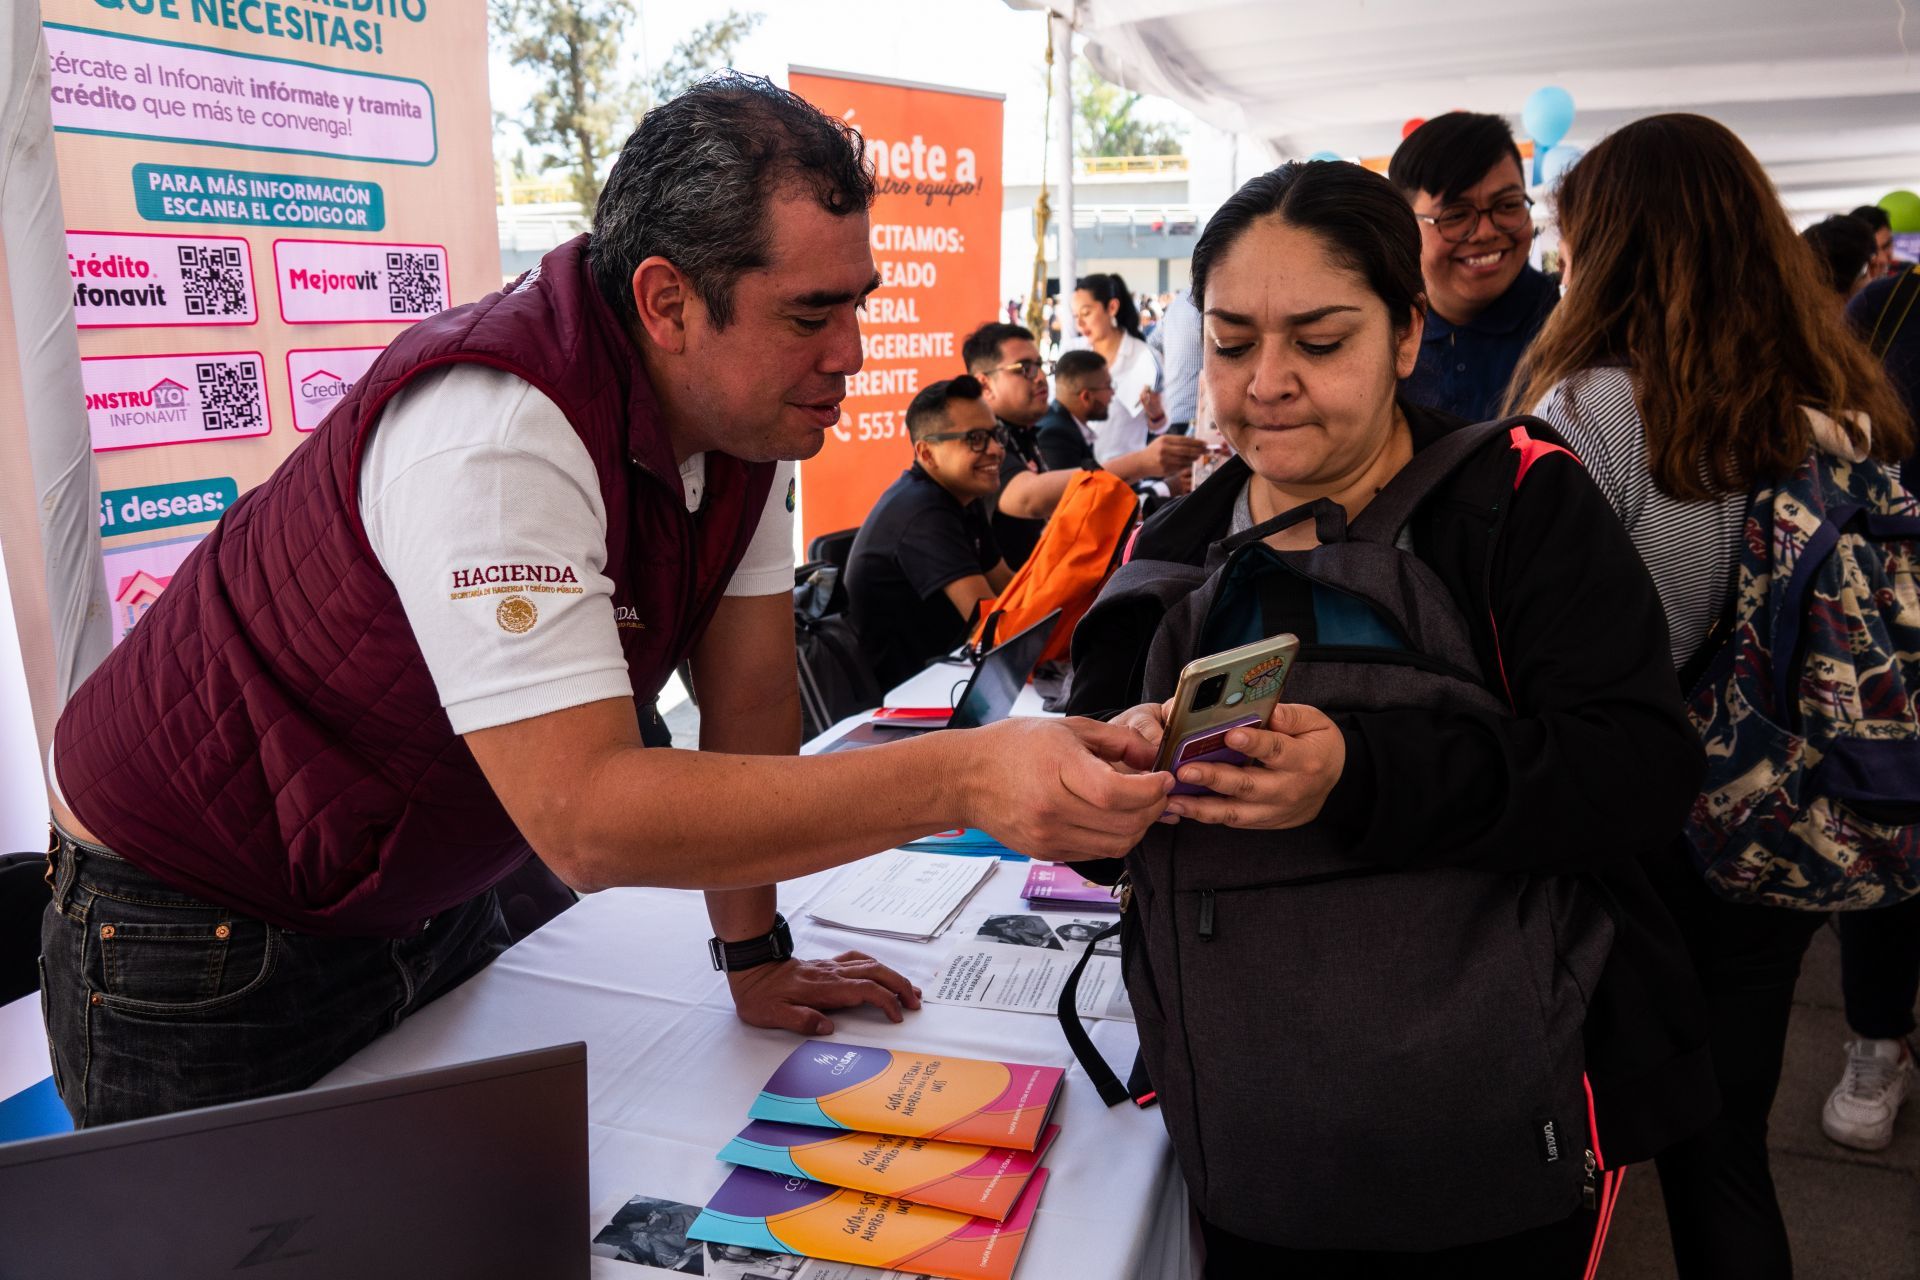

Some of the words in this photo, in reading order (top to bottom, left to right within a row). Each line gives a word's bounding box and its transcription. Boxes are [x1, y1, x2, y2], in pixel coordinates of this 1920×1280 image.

[191, 0, 384, 54] NECESITAS!
[134, 63, 152, 84] al
[158, 65, 246, 97] Infonavit
[250, 78, 340, 109] infórmate
[343, 97, 354, 115] y
[358, 95, 422, 119] tramita
[51, 83, 137, 111] crédito
[143, 97, 186, 119] que
[192, 100, 233, 123] más
[237, 106, 256, 125] te
[262, 110, 352, 139] convenga!
[852, 124, 948, 182] nete
[956, 147, 977, 183] a
[148, 172, 204, 194] PARA
[206, 174, 248, 197] MÁS
[250, 179, 371, 205] INFORMACIÓN
[915, 178, 984, 207] equipo!
[162, 197, 250, 220] ESCANEA
[251, 202, 270, 221] EL
[273, 200, 343, 224] CÓDIGO
[345, 208, 368, 226] QR
[870, 223, 965, 253] CITAMOS:
[289, 268, 379, 295] Mejoravit
[881, 261, 937, 288] EADO
[73, 282, 167, 306] fonavit
[856, 297, 920, 324] NERAL
[845, 368, 919, 397] ERENTE
[110, 408, 188, 427] INFONAVIT
[858, 411, 895, 441] 553
[897, 409, 908, 437] 7
[121, 491, 224, 523] deseas:
[452, 564, 579, 588] HACIENDA
[492, 586, 524, 595] HACIENDA
[901, 1090, 921, 1117] AHORRO
[873, 1149, 900, 1173] AHORRO
[842, 1215, 866, 1235] GUÍA
[860, 1213, 885, 1242] AHORRO
